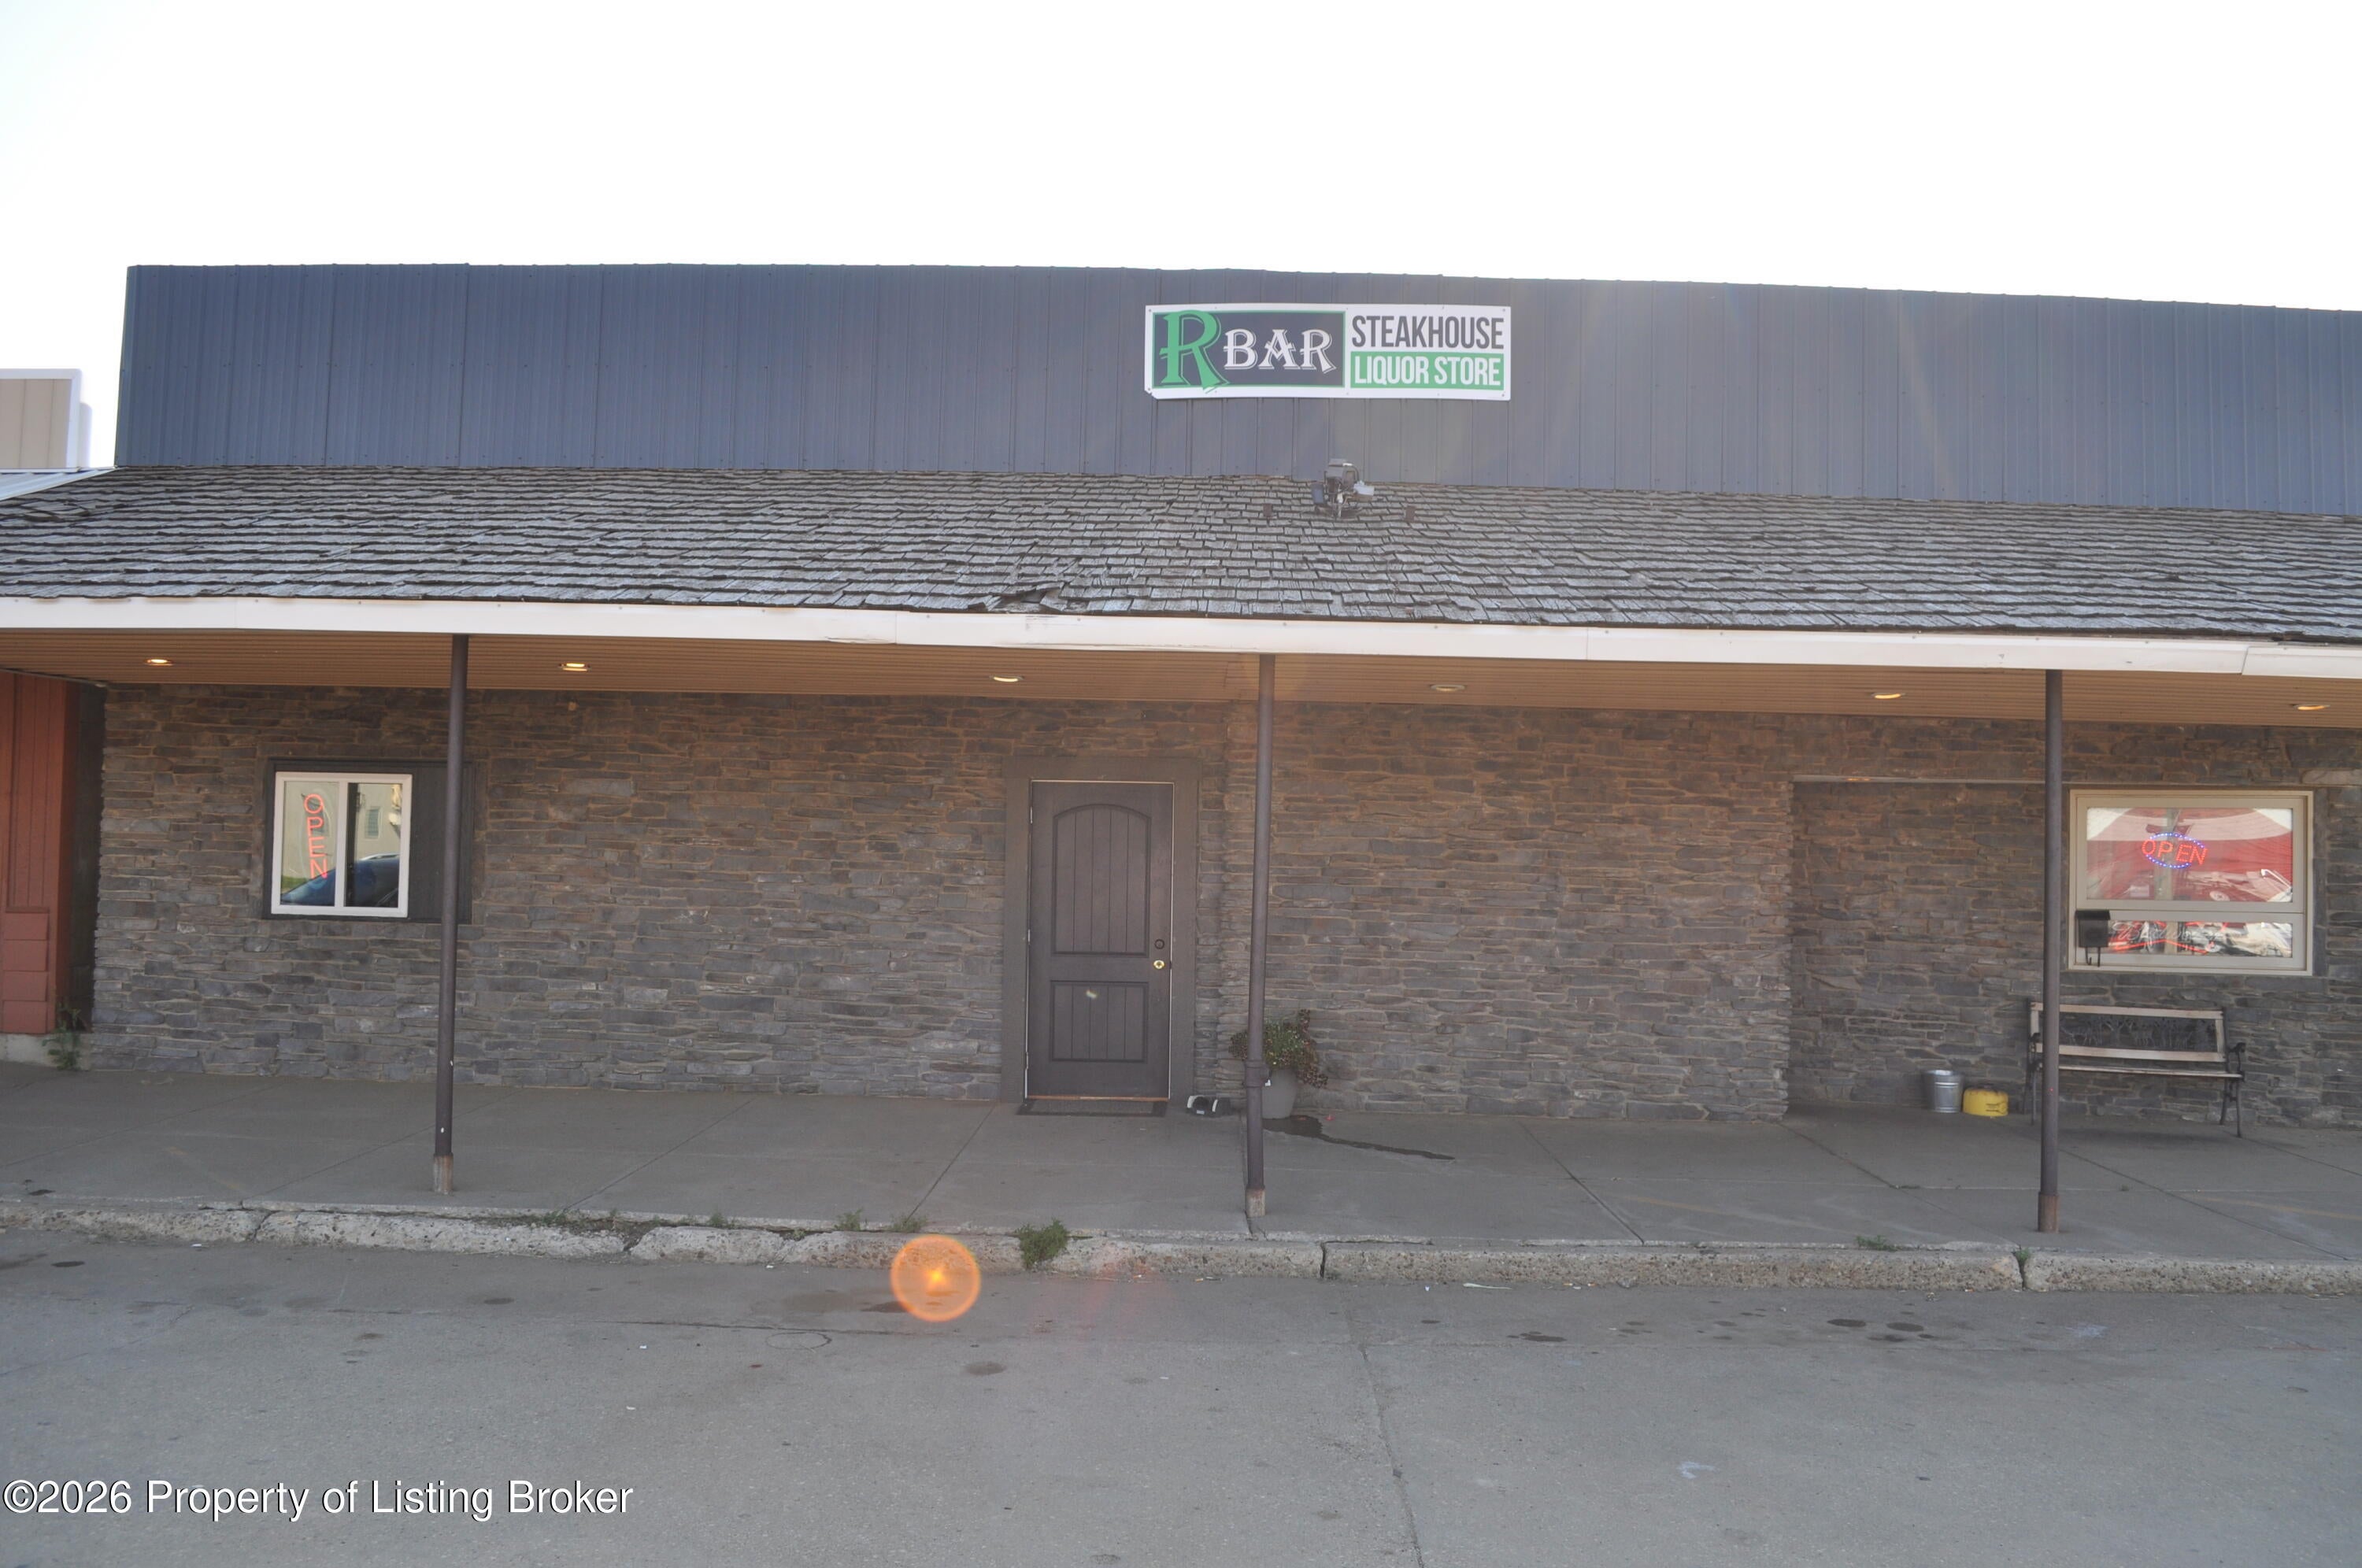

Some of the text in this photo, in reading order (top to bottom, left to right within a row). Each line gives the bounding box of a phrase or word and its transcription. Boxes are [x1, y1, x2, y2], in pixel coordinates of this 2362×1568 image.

[1352, 315, 1505, 349] STEAKHOUSE
[1160, 310, 1336, 393] R BAR
[1355, 355, 1501, 386] LIQUOR STORE
[305, 793, 328, 879] OPEN
[2142, 839, 2208, 865] OPEN
